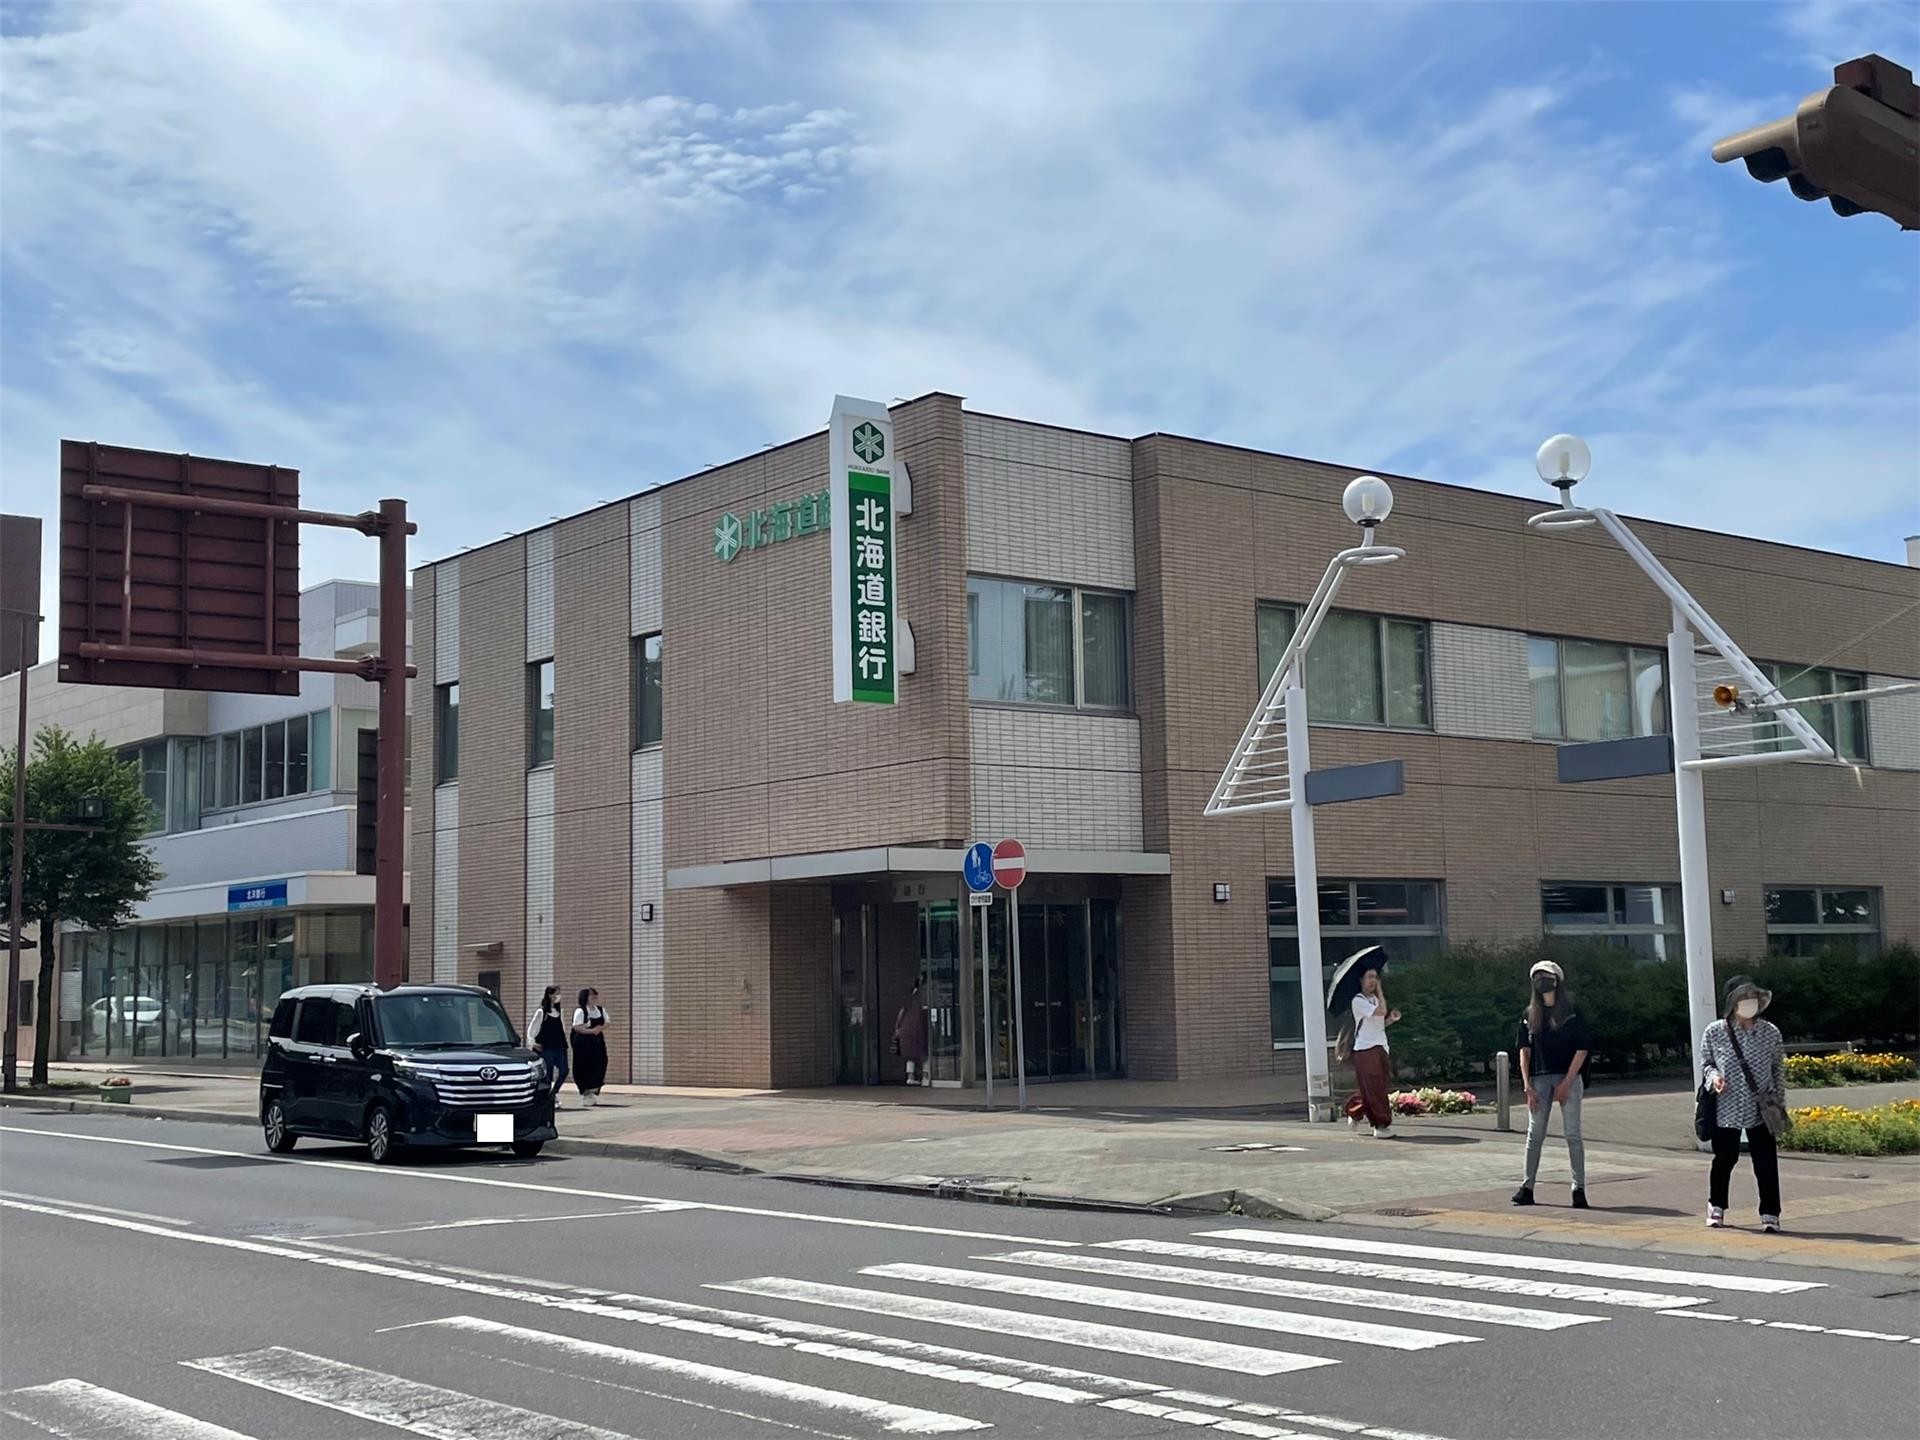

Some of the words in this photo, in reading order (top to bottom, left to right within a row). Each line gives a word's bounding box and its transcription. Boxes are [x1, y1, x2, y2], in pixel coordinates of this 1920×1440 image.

[856, 497, 887, 680] 北海道銀行
